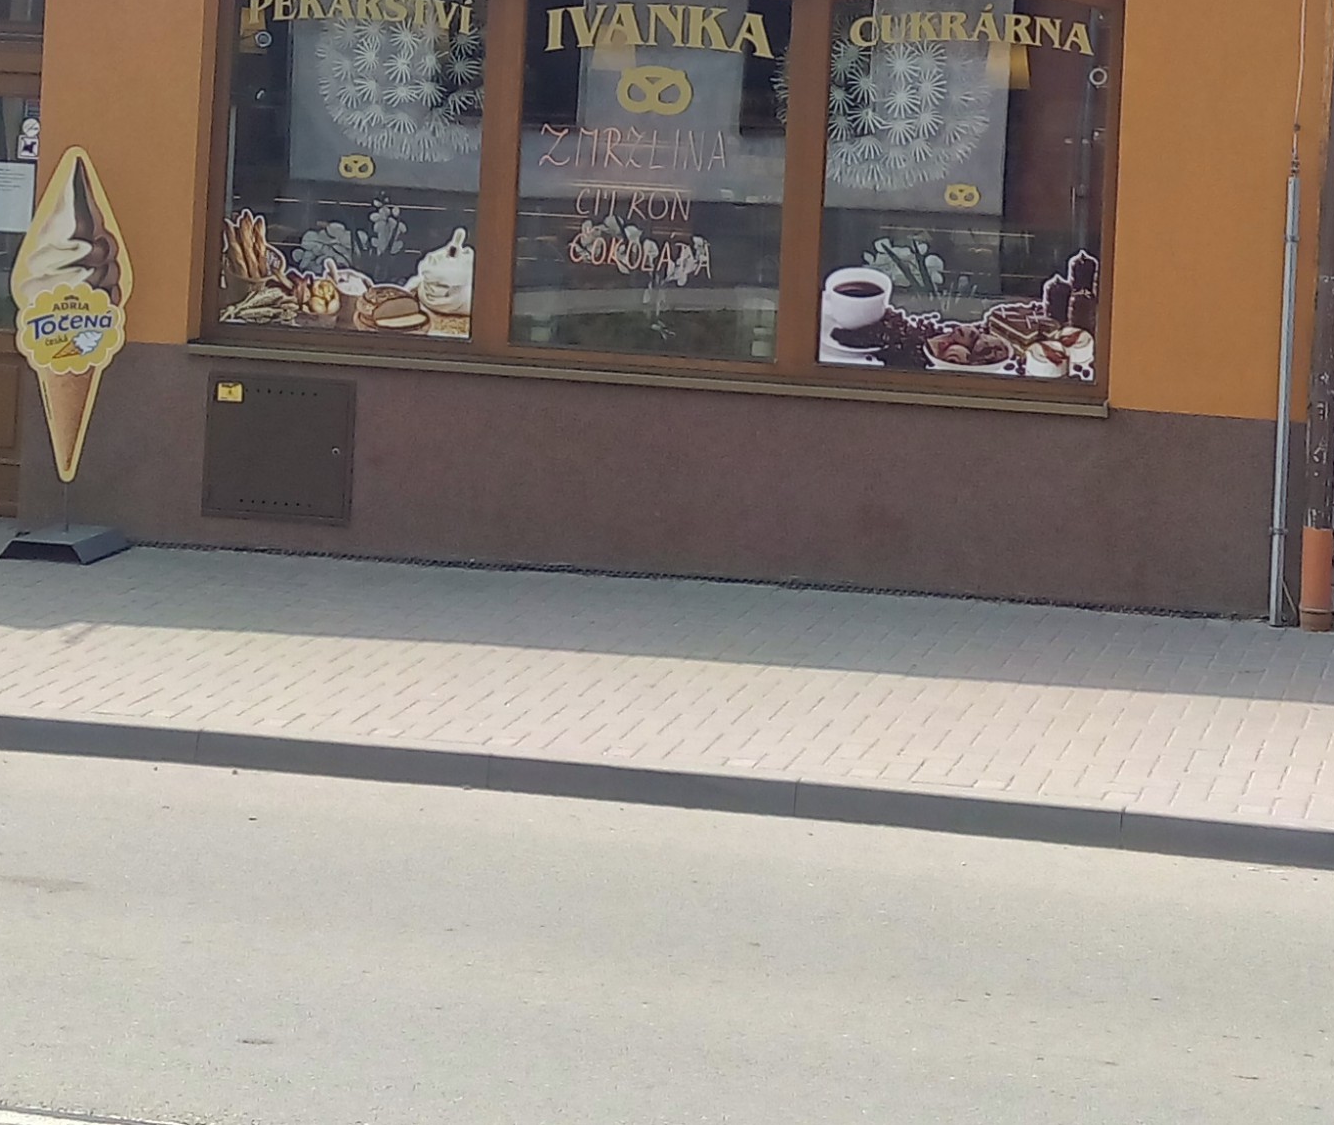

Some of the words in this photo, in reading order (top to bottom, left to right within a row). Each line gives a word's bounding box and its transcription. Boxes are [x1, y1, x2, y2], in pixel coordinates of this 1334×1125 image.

[543, 3, 774, 60] IVANKA
[849, 3, 1094, 55] CUKRÁRNA
[538, 123, 726, 172] ZMRZLINA
[53, 302, 89, 311] ADRIA
